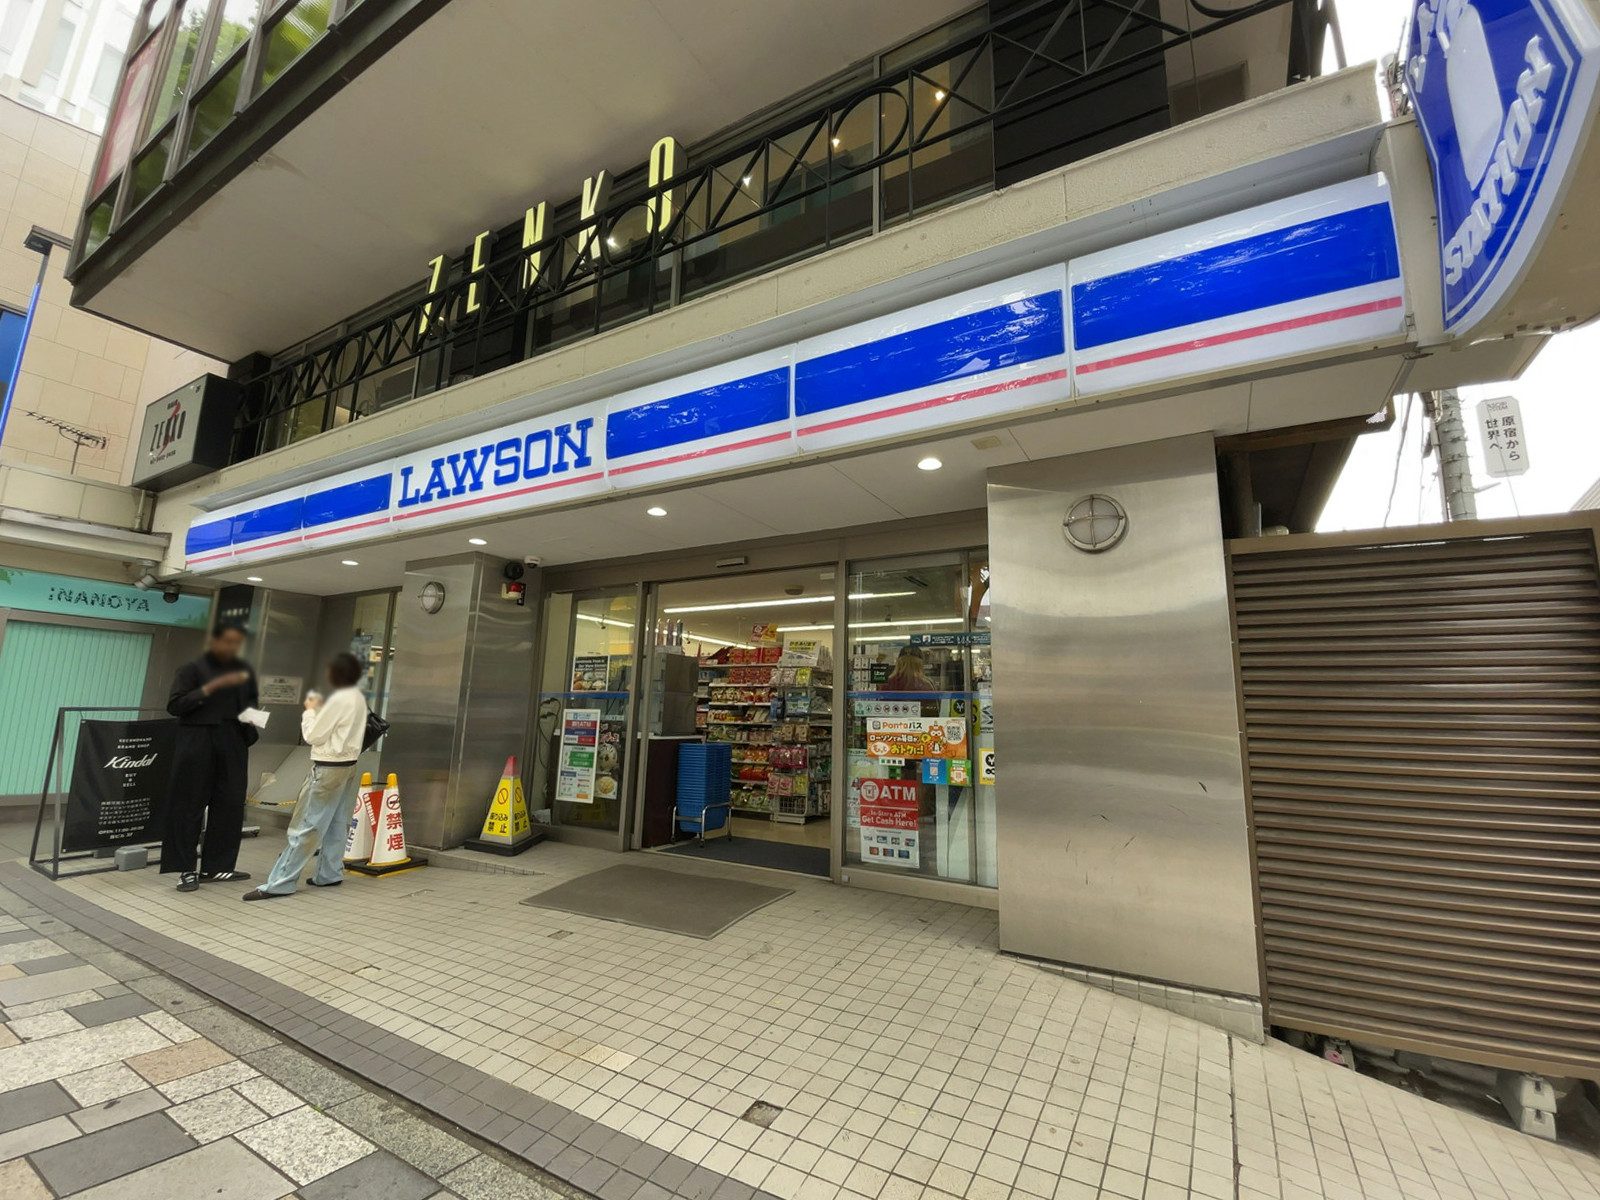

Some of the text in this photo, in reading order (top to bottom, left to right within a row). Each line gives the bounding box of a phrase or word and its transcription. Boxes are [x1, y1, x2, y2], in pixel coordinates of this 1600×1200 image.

[1486, 418, 1503, 450] 世界へ
[1502, 415, 1520, 461] 原宿から
[397, 417, 594, 508] LAWSON
[882, 721, 923, 730] Pontaパス
[103, 753, 158, 769] Kindal
[880, 785, 916, 801] ATM
[386, 812, 403, 851] 禁煙
[862, 815, 917, 827] Get Cash Here!
